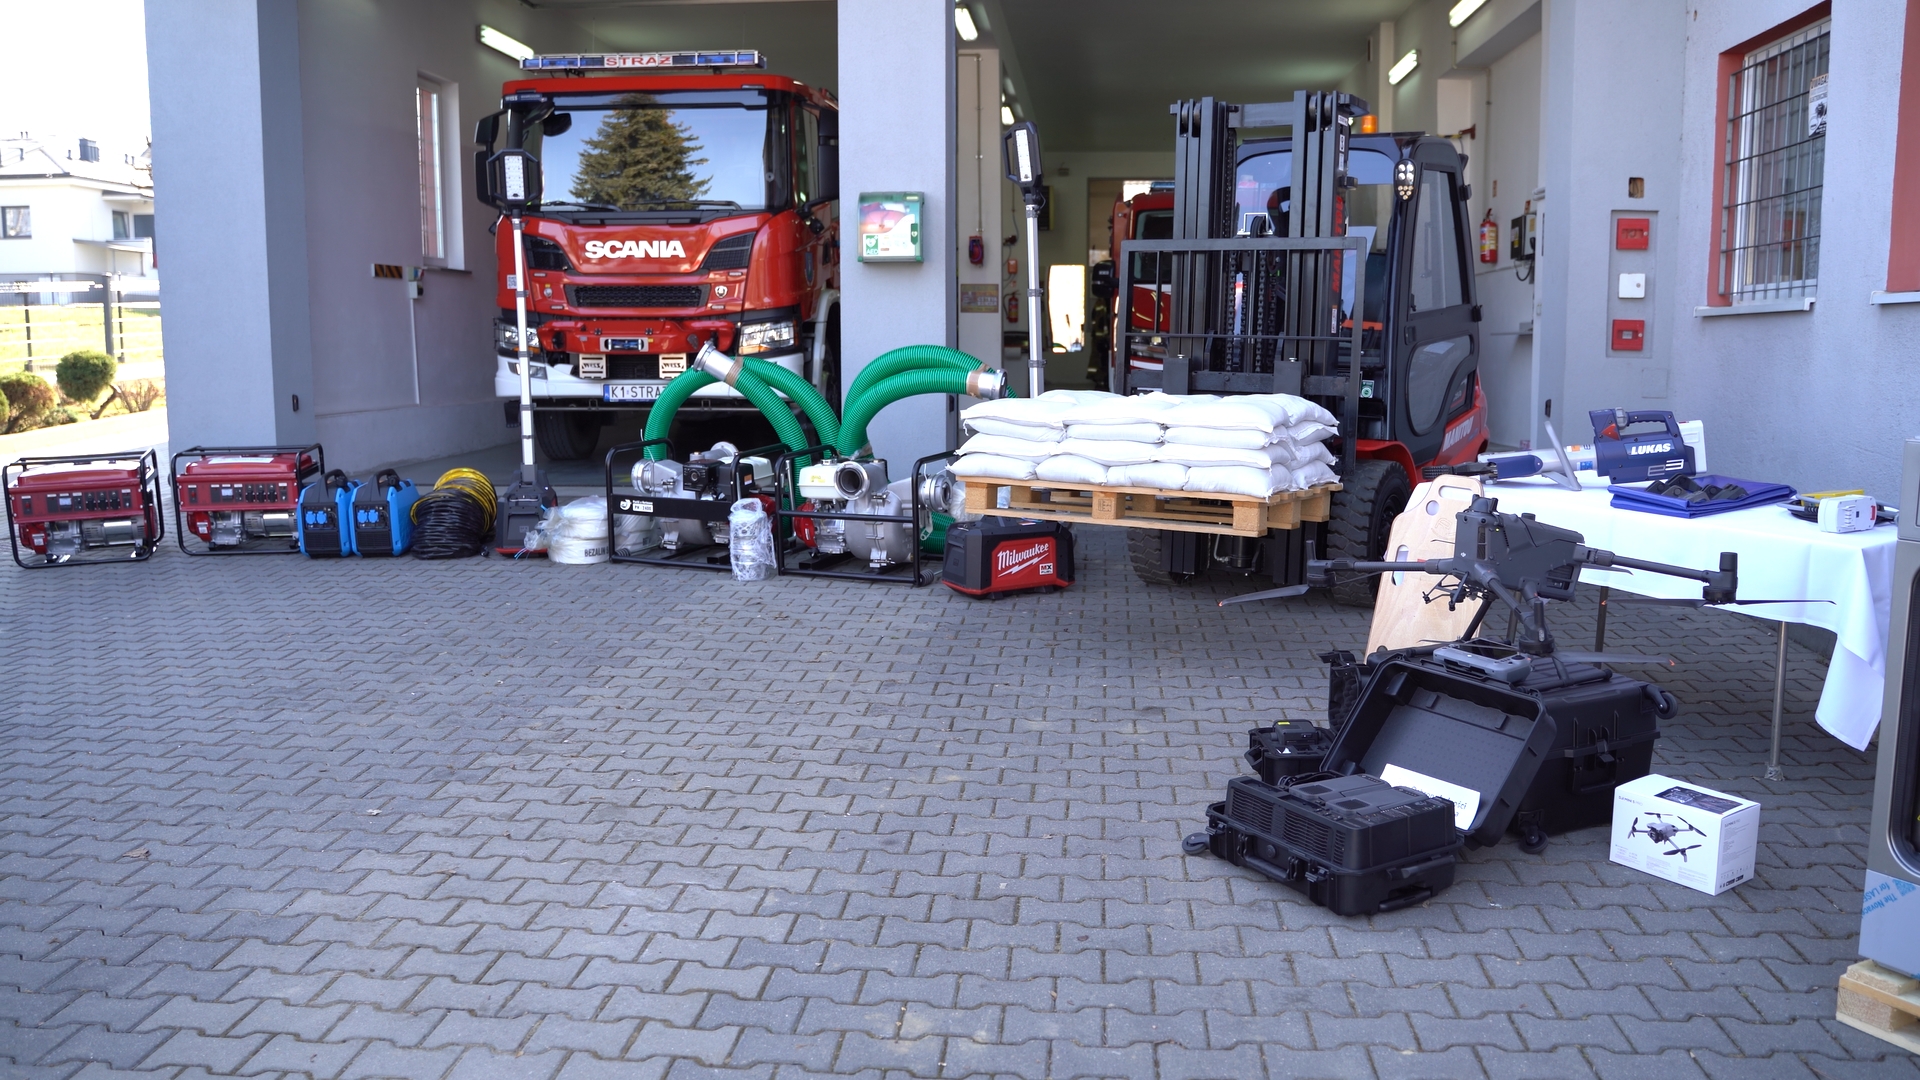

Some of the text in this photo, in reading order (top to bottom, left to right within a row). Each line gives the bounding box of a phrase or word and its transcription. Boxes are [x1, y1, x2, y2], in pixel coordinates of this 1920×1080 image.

[584, 240, 686, 259] SCANIA
[611, 386, 625, 398] K1
[630, 386, 666, 398] STRA
[1442, 415, 1474, 452] MANITOU
[1631, 443, 1671, 455] LUKAS
[584, 546, 606, 558] BEZALIN
[997, 543, 1049, 571] Milwaukee
[1880, 882, 1890, 891] for
[1883, 893, 1898, 903] The
